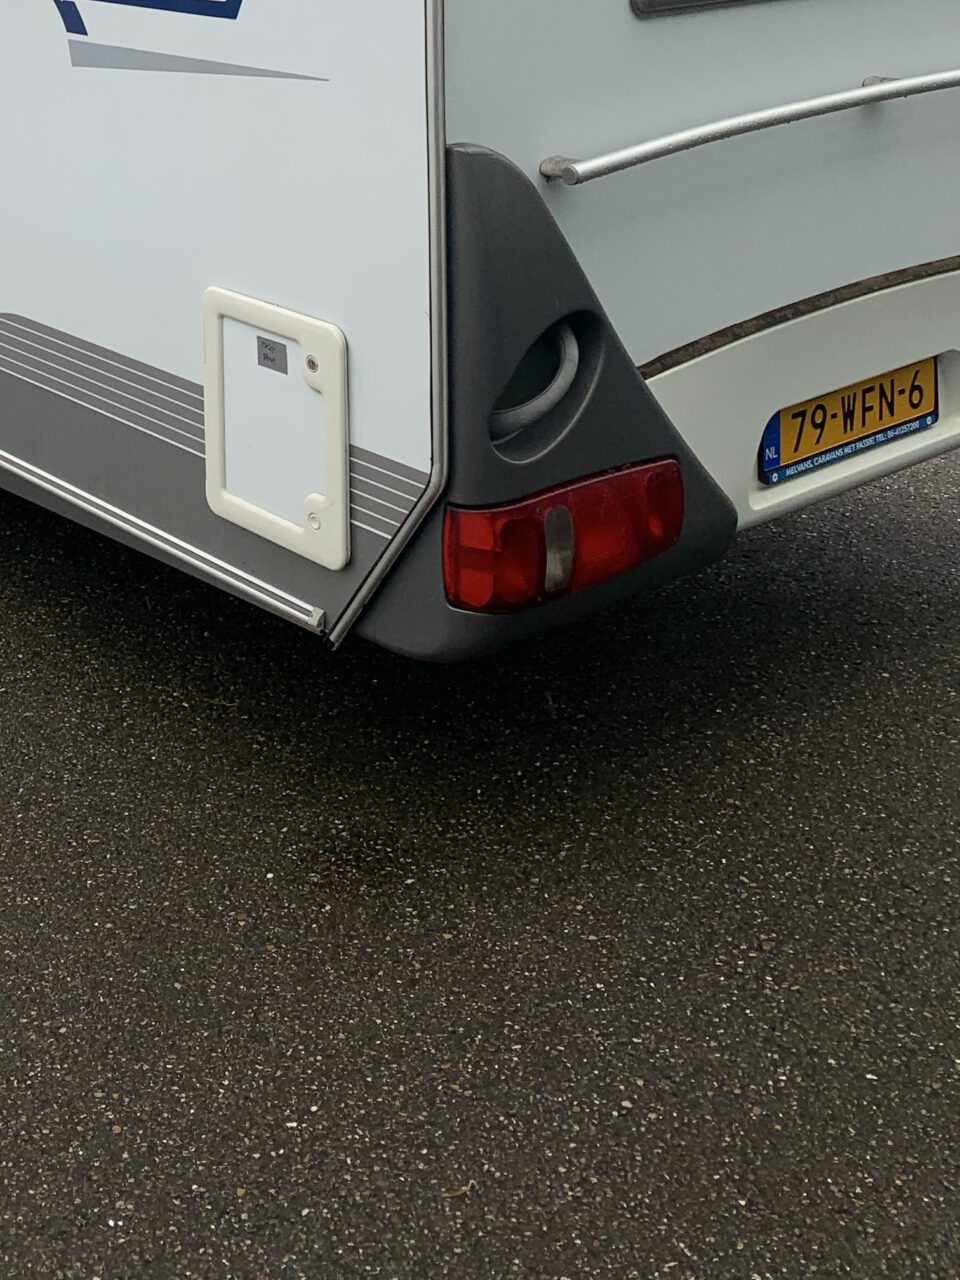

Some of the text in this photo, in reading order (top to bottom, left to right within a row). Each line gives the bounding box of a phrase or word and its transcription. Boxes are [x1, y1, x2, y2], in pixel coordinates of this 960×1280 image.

[791, 369, 924, 454] 79-WFN-6
[765, 446, 779, 461] NL
[813, 448, 844, 466] CARAVANS
[843, 442, 857, 454] MET
